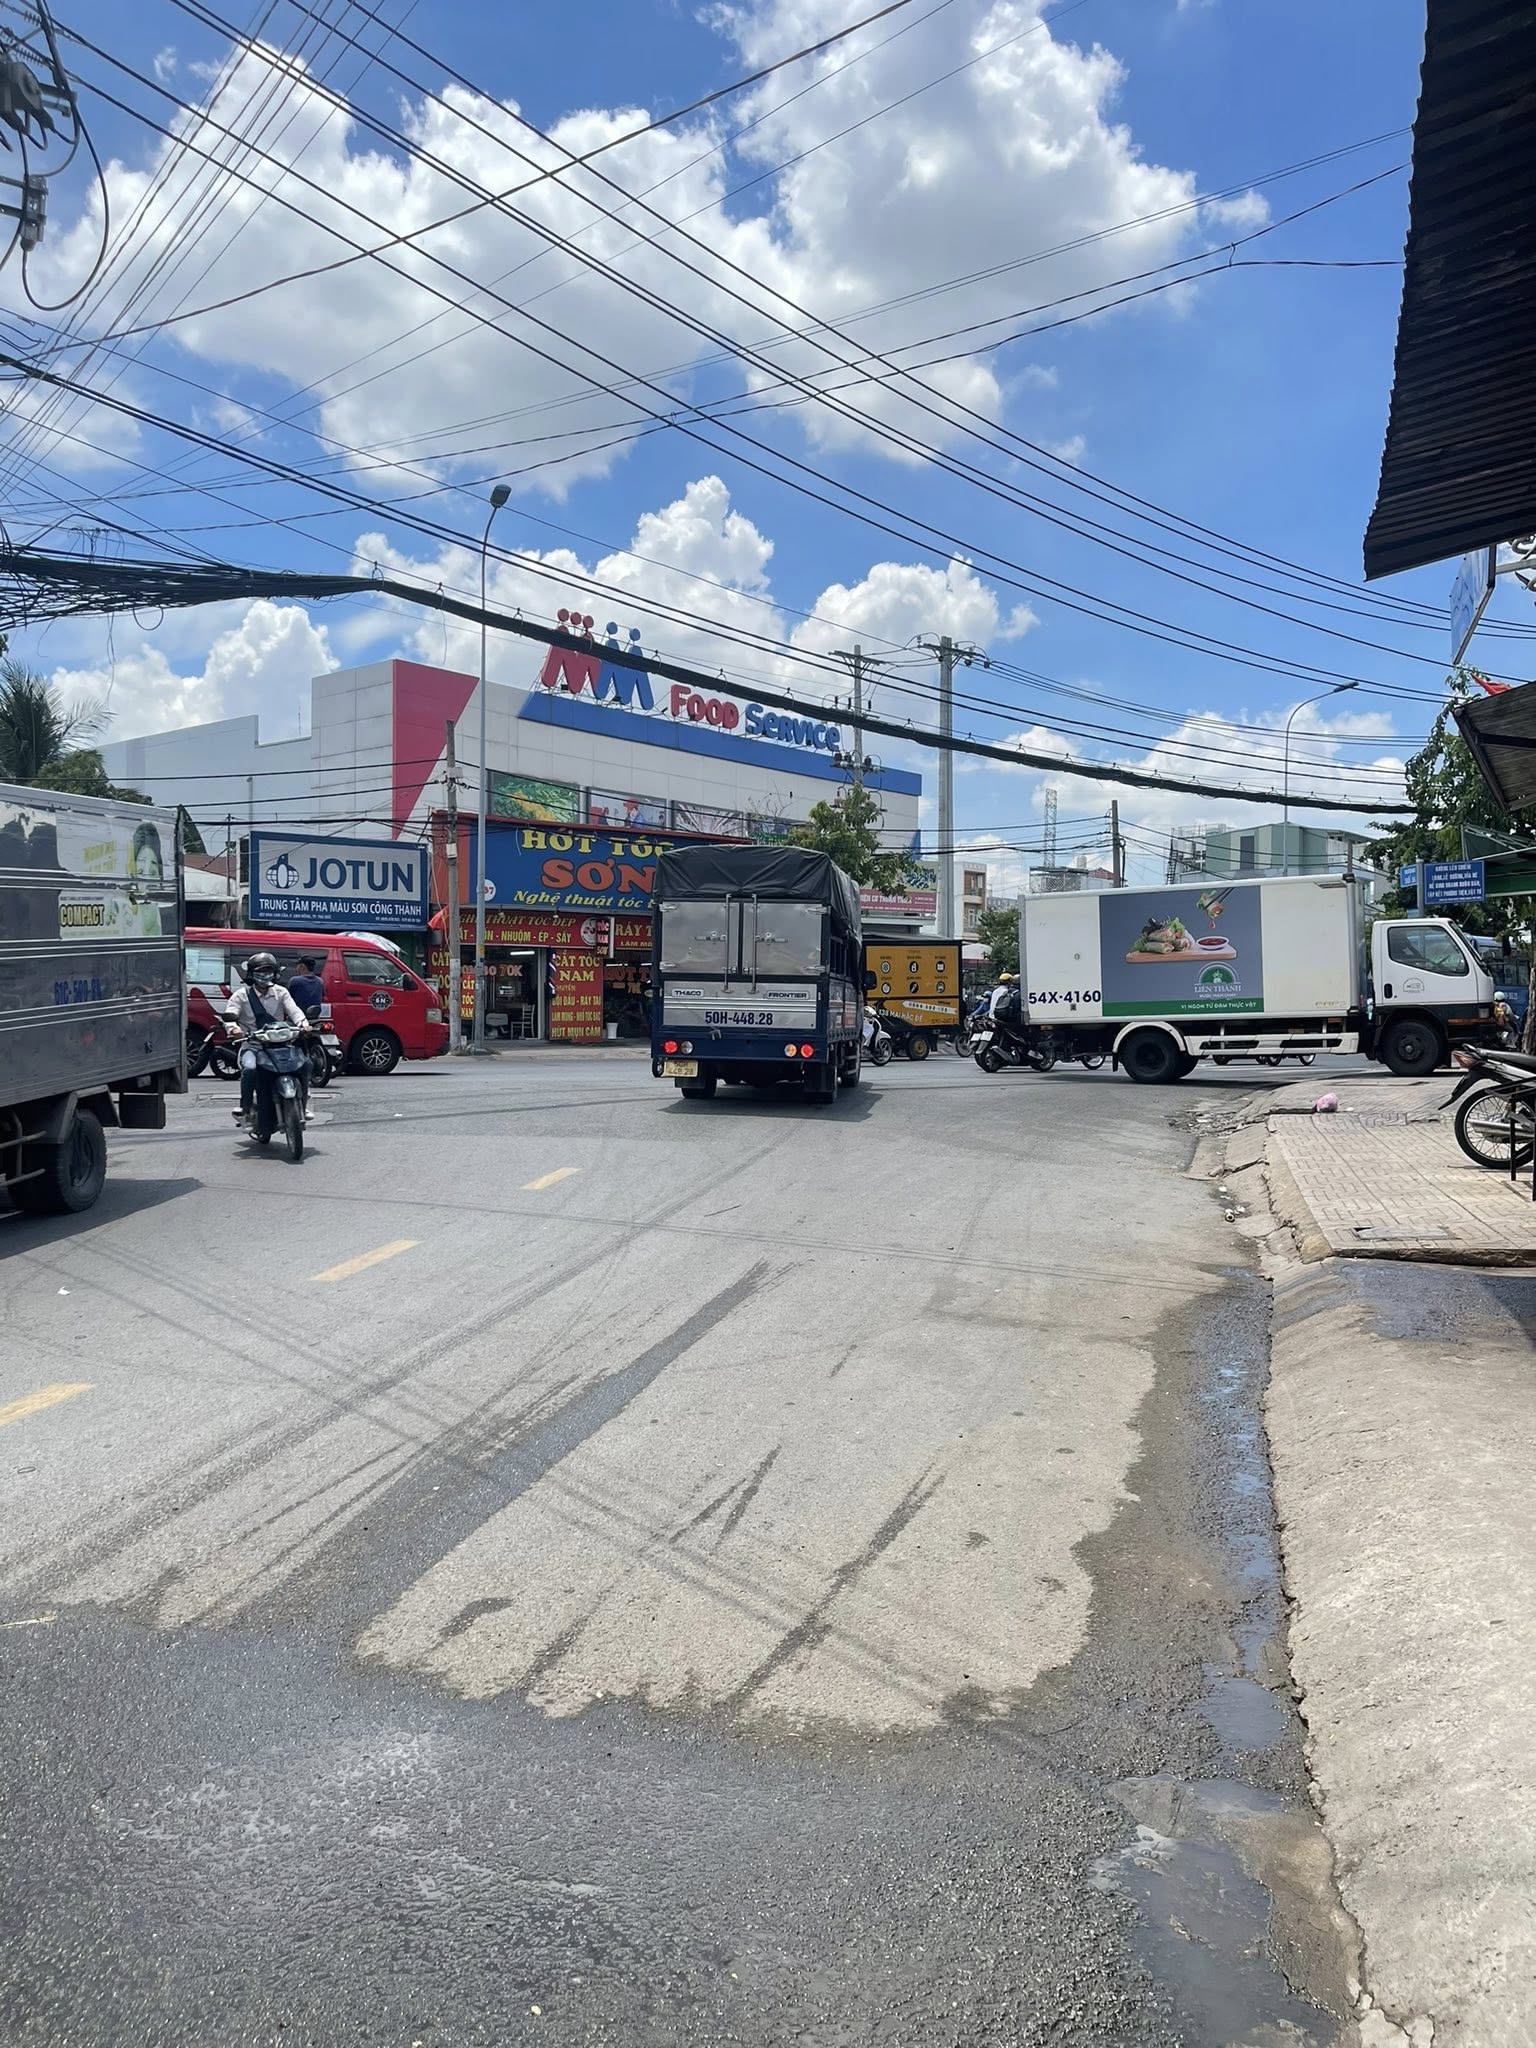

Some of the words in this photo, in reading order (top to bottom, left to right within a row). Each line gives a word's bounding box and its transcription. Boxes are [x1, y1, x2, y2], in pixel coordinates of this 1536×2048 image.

[303, 857, 413, 893] JOTUN
[541, 857, 656, 895] SƠN
[259, 899, 288, 910] TRUNG
[290, 897, 309, 911] TÂM
[311, 901, 327, 912] PHA
[329, 899, 350, 913] MÀU
[351, 901, 368, 914] SƠN
[370, 901, 393, 914] CÔNG
[395, 903, 422, 916] THÀNH
[514, 890, 561, 906] Nghệ
[565, 894, 614, 907] thuật
[617, 896, 642, 908] tóc
[60, 904, 104, 927] COMPACT
[615, 921, 642, 936] RÁY
[646, 926, 653, 937] T
[580, 952, 600, 967] TÓC
[559, 971, 594, 981] NAM
[705, 1011, 773, 1026] 50H-448.28
